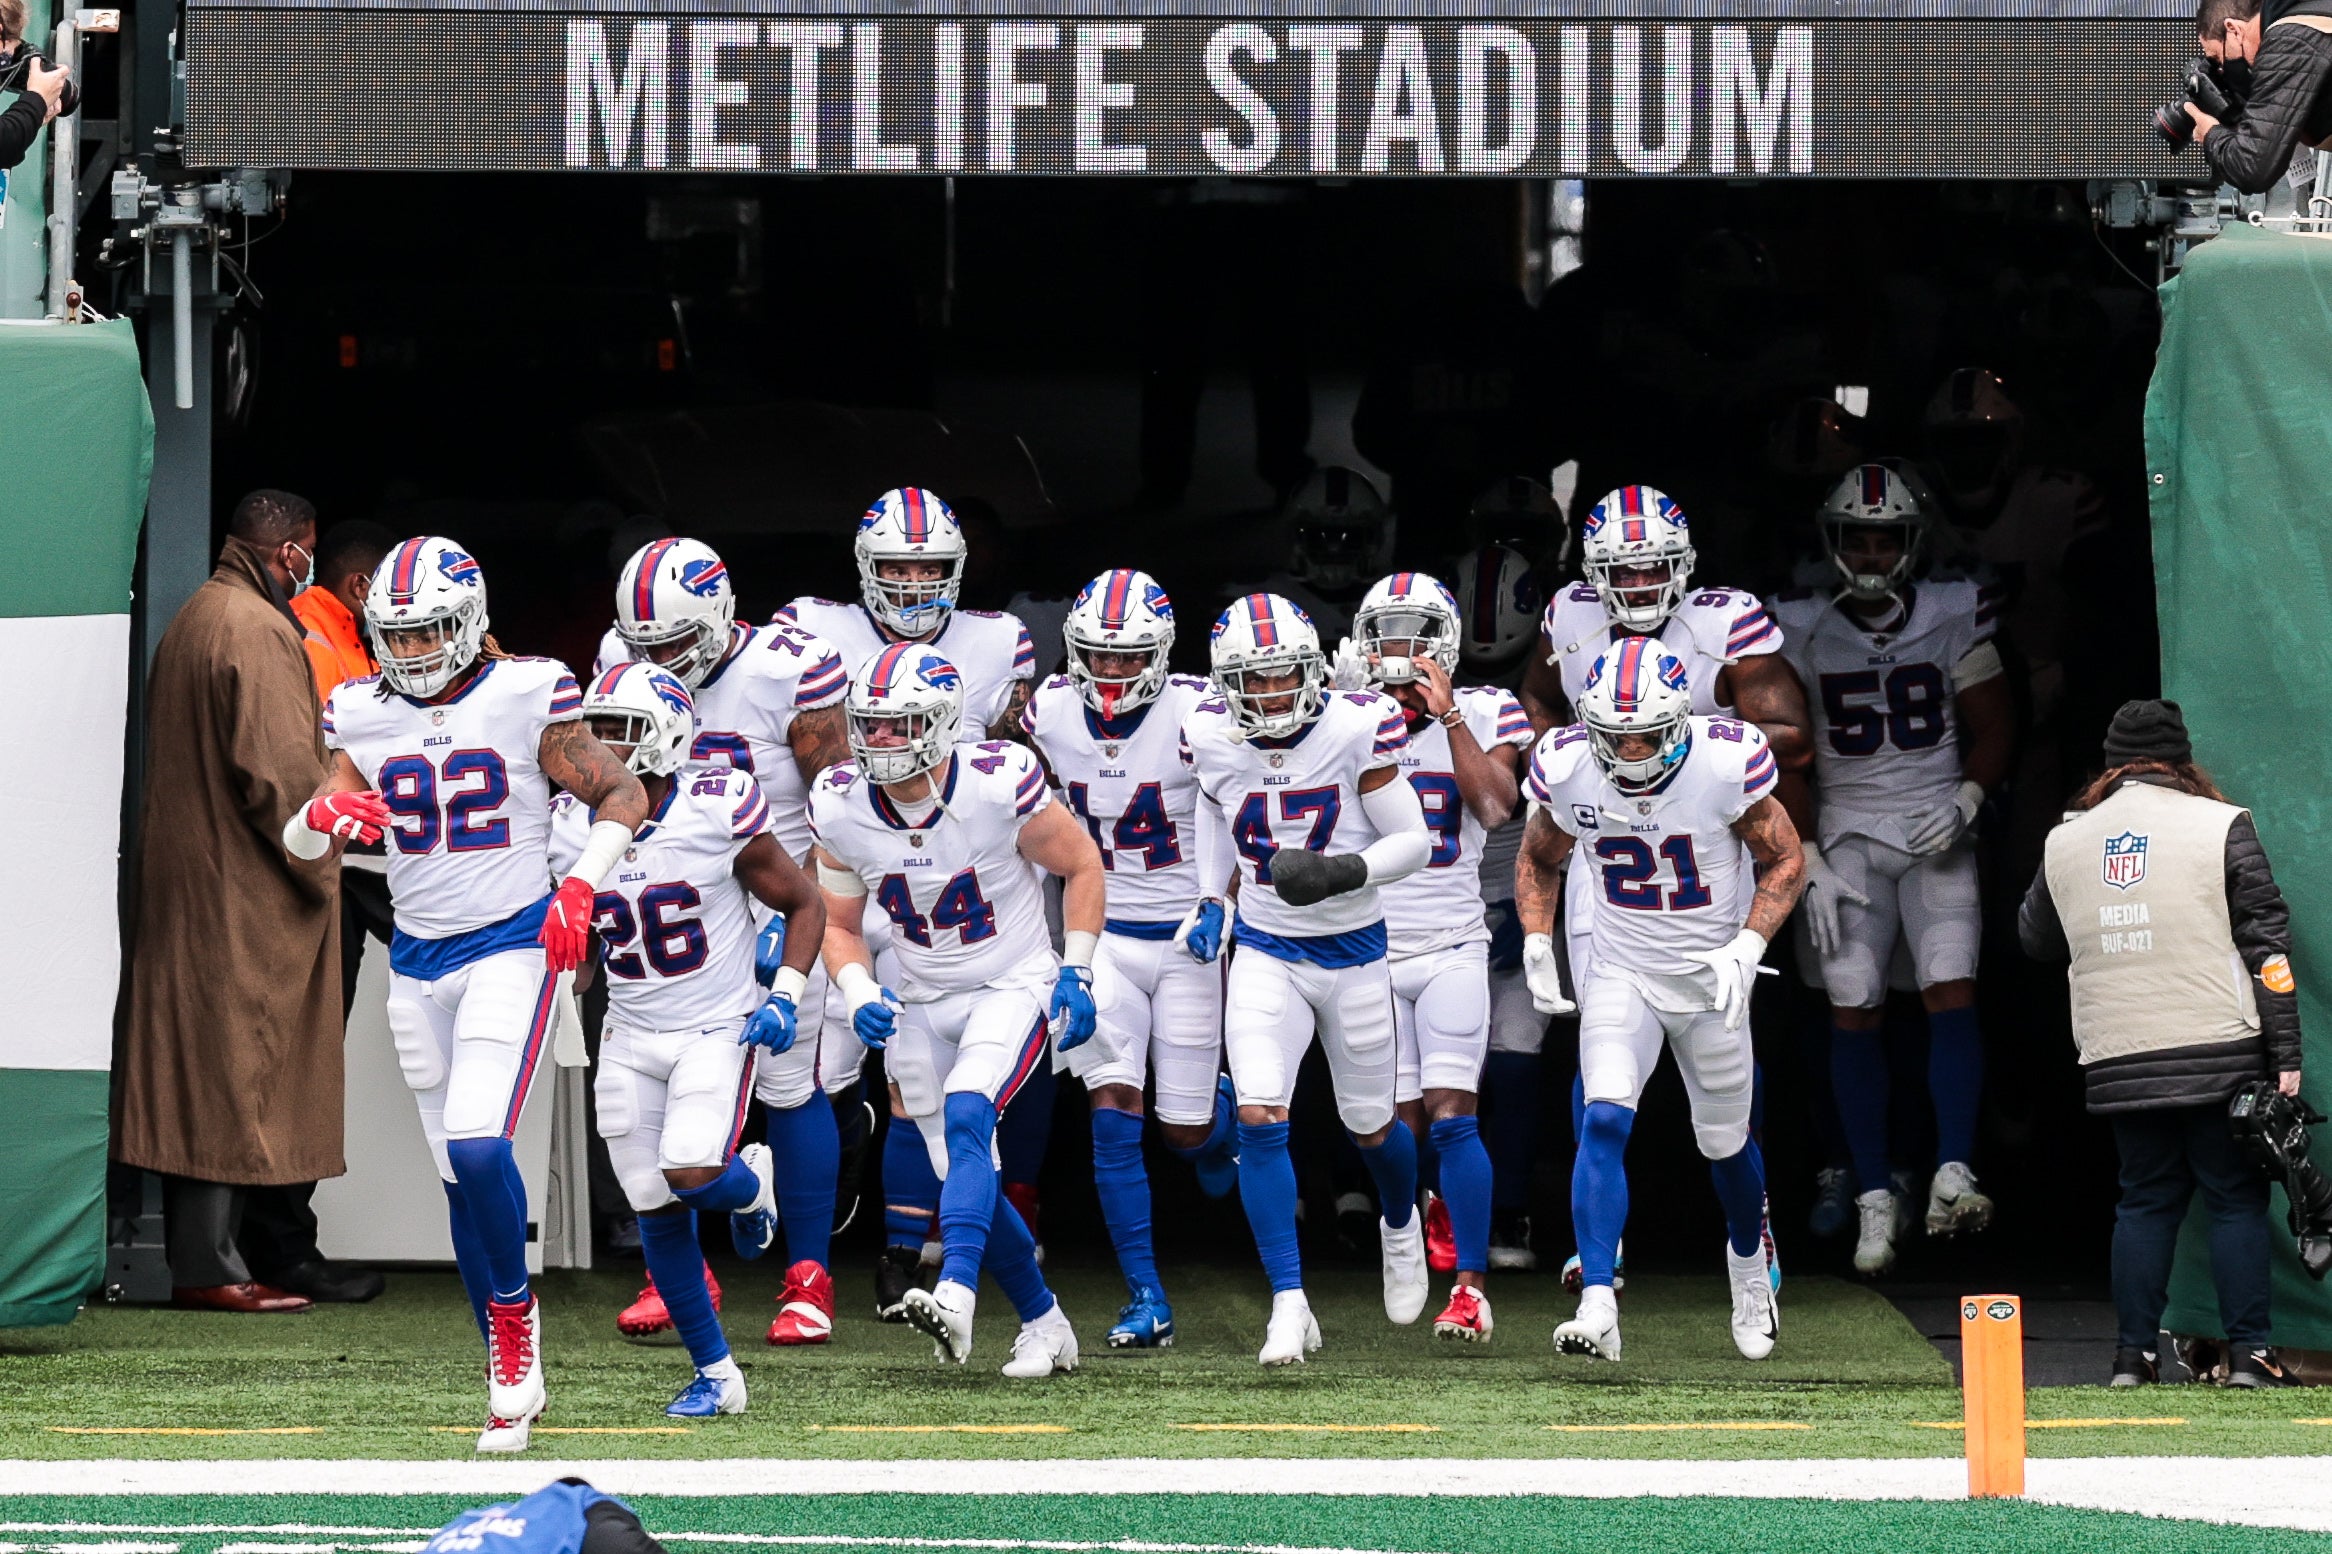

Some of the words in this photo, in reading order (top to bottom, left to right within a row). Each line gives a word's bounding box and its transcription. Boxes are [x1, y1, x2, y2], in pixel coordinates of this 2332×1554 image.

[564, 19, 1148, 171] METLIFE
[1201, 22, 1814, 174] STADIUM
[423, 736, 452, 747] BILLS
[1820, 661, 1945, 756] 58
[378, 748, 511, 855] 92
[1263, 776, 1290, 785] BILLS
[1068, 780, 1183, 872] 14
[1232, 783, 1342, 885] 47
[877, 866, 998, 949] 44
[1594, 834, 1712, 912] 21
[2107, 855, 2141, 882] NFL
[592, 880, 710, 979] 26
[2099, 903, 2151, 927] MEDIA
[2101, 929, 2153, 954] BUF-027
